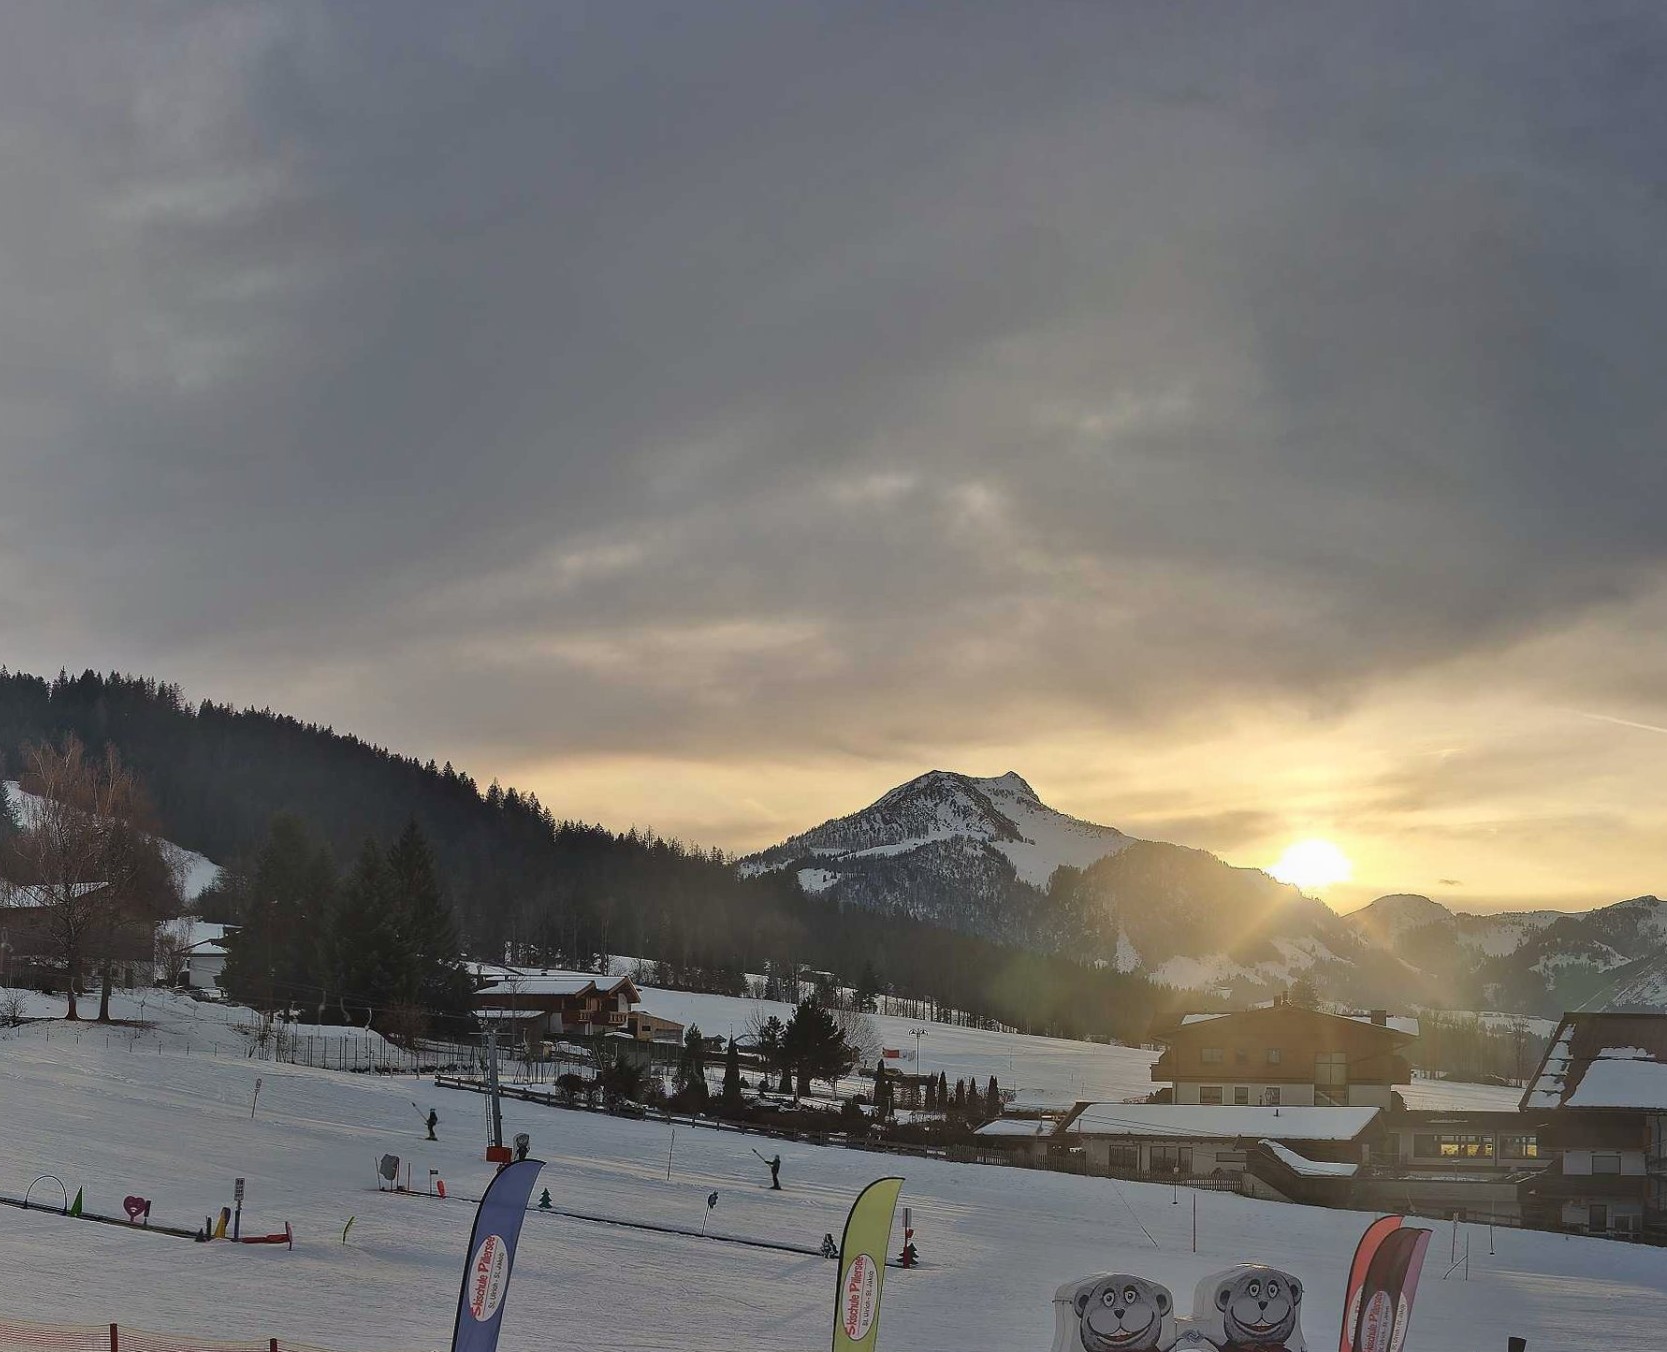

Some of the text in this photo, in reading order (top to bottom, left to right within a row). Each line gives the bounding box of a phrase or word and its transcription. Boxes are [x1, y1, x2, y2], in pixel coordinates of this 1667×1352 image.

[470, 1236, 495, 1318] Skischule Pillersee
[845, 1256, 864, 1335] Skischule Pillersee
